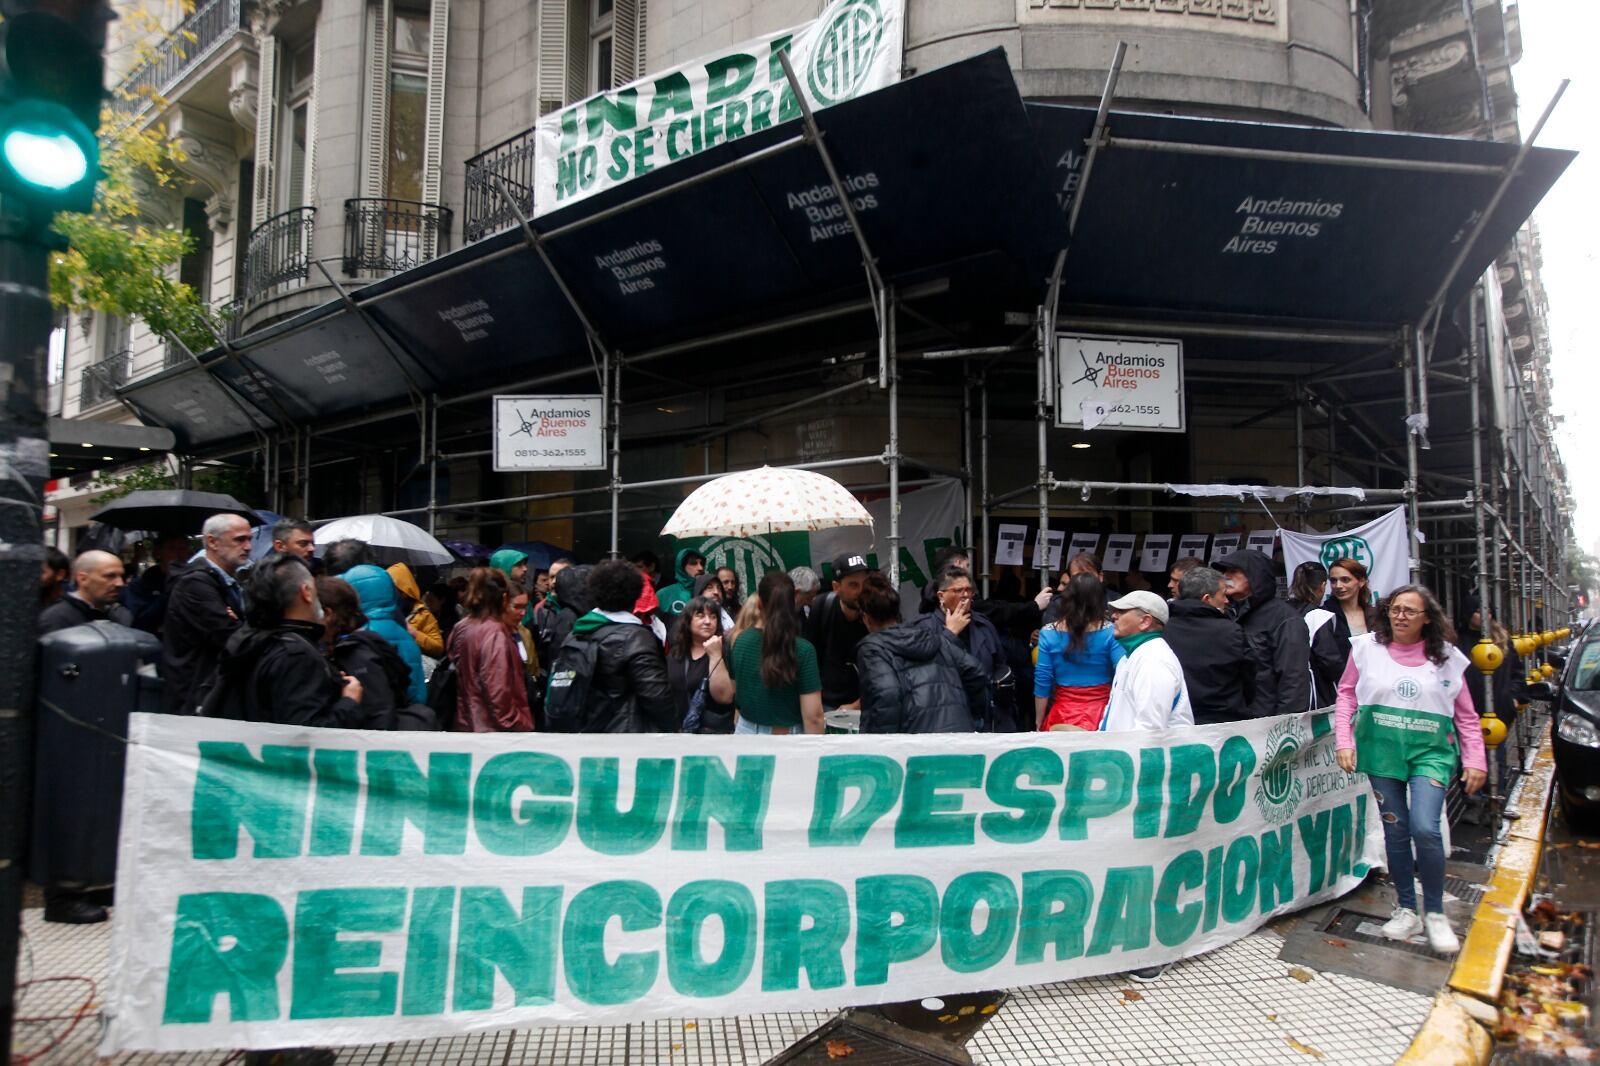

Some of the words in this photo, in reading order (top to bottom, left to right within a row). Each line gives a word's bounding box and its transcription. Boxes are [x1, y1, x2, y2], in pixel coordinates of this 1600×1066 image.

[556, 145, 598, 201] NO
[606, 126, 655, 181] SE
[805, 194, 878, 223] Bueos
[1235, 195, 1344, 218] Andamios
[1241, 216, 1321, 237] Buenos
[595, 238, 663, 269] Andamios
[1222, 235, 1279, 254] Aires
[611, 255, 667, 281] Buenos
[618, 275, 655, 296] Aires
[1096, 351, 1165, 368] Andamios
[1102, 376, 1138, 389] Aires
[1107, 364, 1160, 379] Buenos
[531, 408, 591, 419] Andamios
[541, 418, 586, 428] Buenos
[536, 427, 567, 437] Aires
[1304, 745, 1320, 769] ATE
[1306, 770, 1344, 799] DERECHOS
[192, 740, 776, 861] NINGUN
[808, 735, 1257, 849] DESPIDO
[162, 823, 1294, 1025] REINCORPORACION
